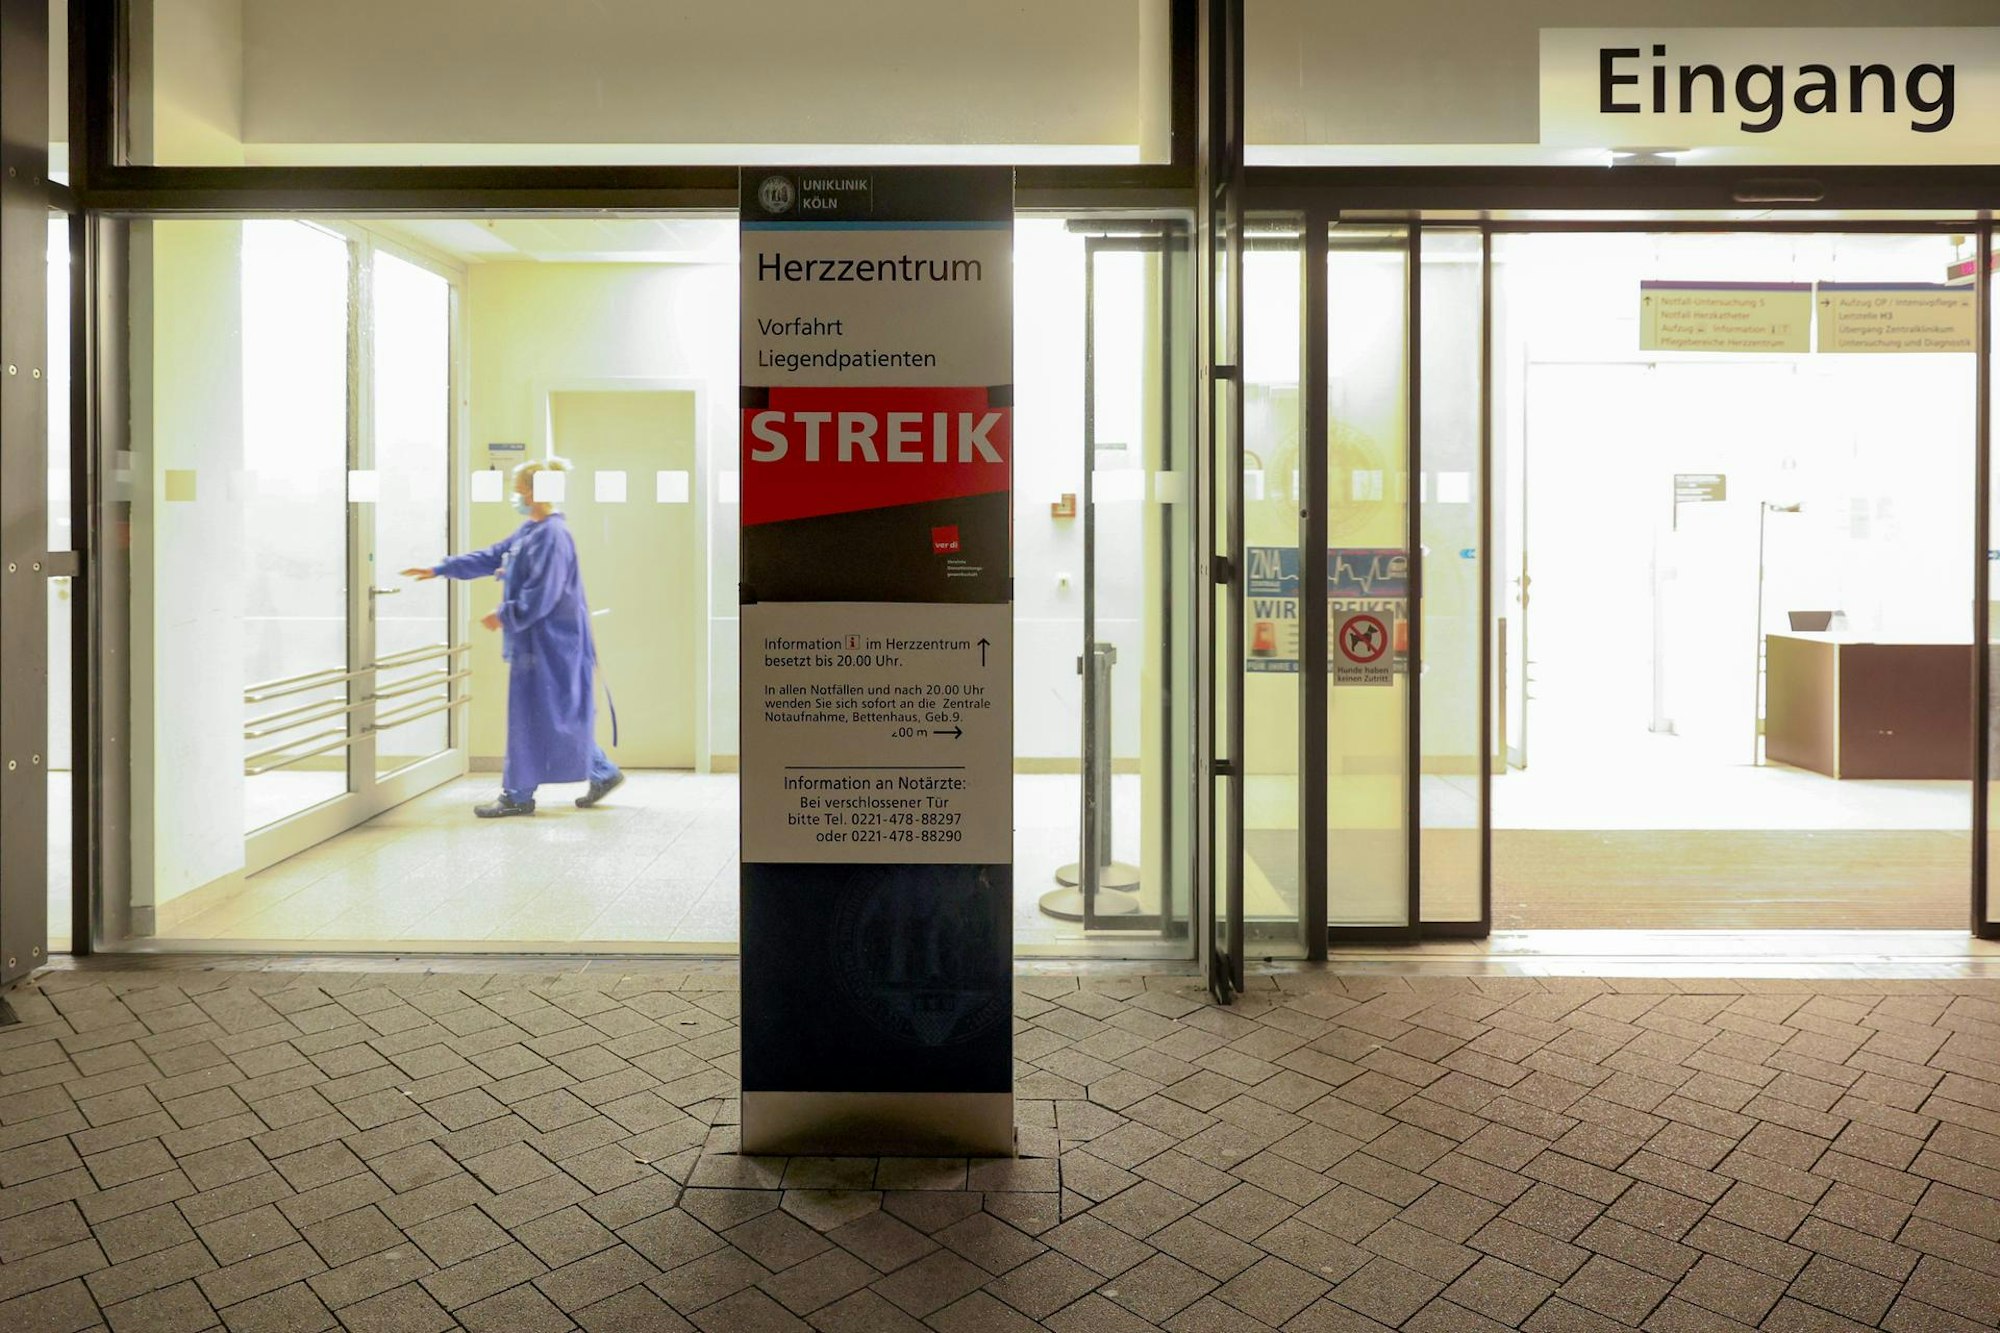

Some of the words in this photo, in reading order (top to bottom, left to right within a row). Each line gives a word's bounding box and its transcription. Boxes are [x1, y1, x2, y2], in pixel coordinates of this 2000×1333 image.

[1600, 44, 1955, 133] Eingang
[803, 179, 868, 191] UNIKLINIK
[803, 196, 838, 209] KÖLN
[758, 253, 982, 281] Herzzentrum
[757, 317, 843, 336] Vorfahrt
[758, 348, 936, 371] Liegendpatienten
[751, 411, 1004, 463] STREIK
[1254, 600, 1297, 619] WIR
[764, 637, 842, 650] Information
[866, 637, 882, 650] im
[886, 638, 971, 650] Herzzentrum
[764, 654, 812, 667] besetzt
[815, 654, 833, 667] bis
[836, 654, 872, 667] 20.00
[875, 654, 902, 667] Uhr.
[1337, 666, 1362, 674] Hunde
[1364, 666, 1389, 674] haben
[1337, 674, 1362, 682] keinen
[764, 684, 776, 695] In
[779, 684, 807, 695] allen
[810, 684, 864, 695] Notfällen
[867, 684, 891, 695] und
[894, 684, 922, 695] nach
[926, 684, 960, 695] 20.00
[963, 684, 984, 695] Uhr
[764, 698, 812, 709] wenden
[815, 698, 832, 709] Sie
[835, 698, 858, 709] sich
[861, 698, 897, 709] sofort
[899, 700, 914, 709] an
[918, 698, 936, 709] die
[943, 698, 991, 709] Zentrale
[765, 711, 848, 723] Notaufnahme,
[852, 711, 921, 723] Bettenhaus,
[925, 711, 963, 723] Geb.9.
[916, 729, 928, 738] m
[784, 776, 871, 790] Information
[875, 779, 893, 790] an
[898, 776, 966, 790] Notärzte:
[800, 797, 821, 809] Bei
[825, 797, 922, 809] verschlossener
[926, 797, 950, 809] Tür
[788, 813, 820, 825] bitte
[824, 813, 847, 825] Tel.
[851, 813, 962, 825] 0221-478-88297
[816, 830, 848, 842] oder
[851, 830, 962, 842] 0221-478-88290
